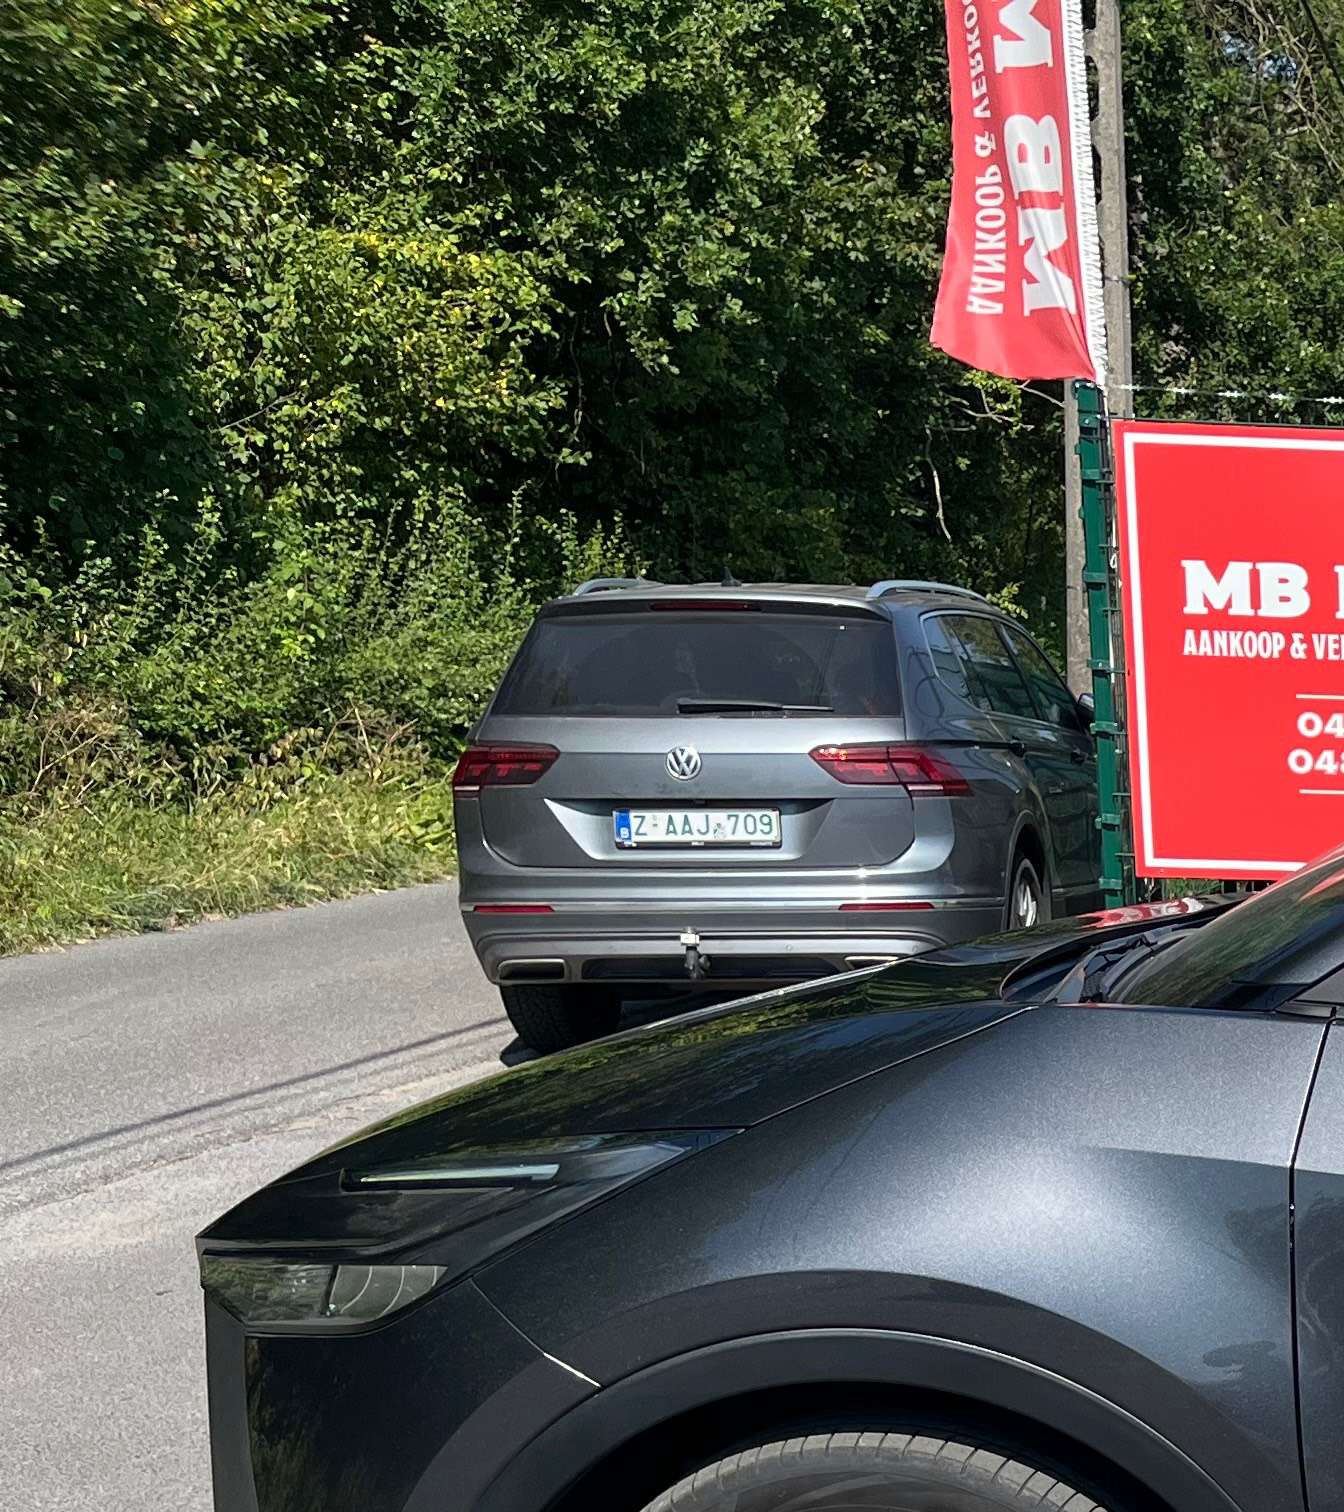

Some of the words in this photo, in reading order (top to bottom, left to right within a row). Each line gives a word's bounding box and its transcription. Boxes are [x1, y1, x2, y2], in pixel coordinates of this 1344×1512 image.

[1181, 560, 1311, 618] MB
[1183, 629, 1285, 658] AANKOOP
[1290, 632, 1308, 659] &
